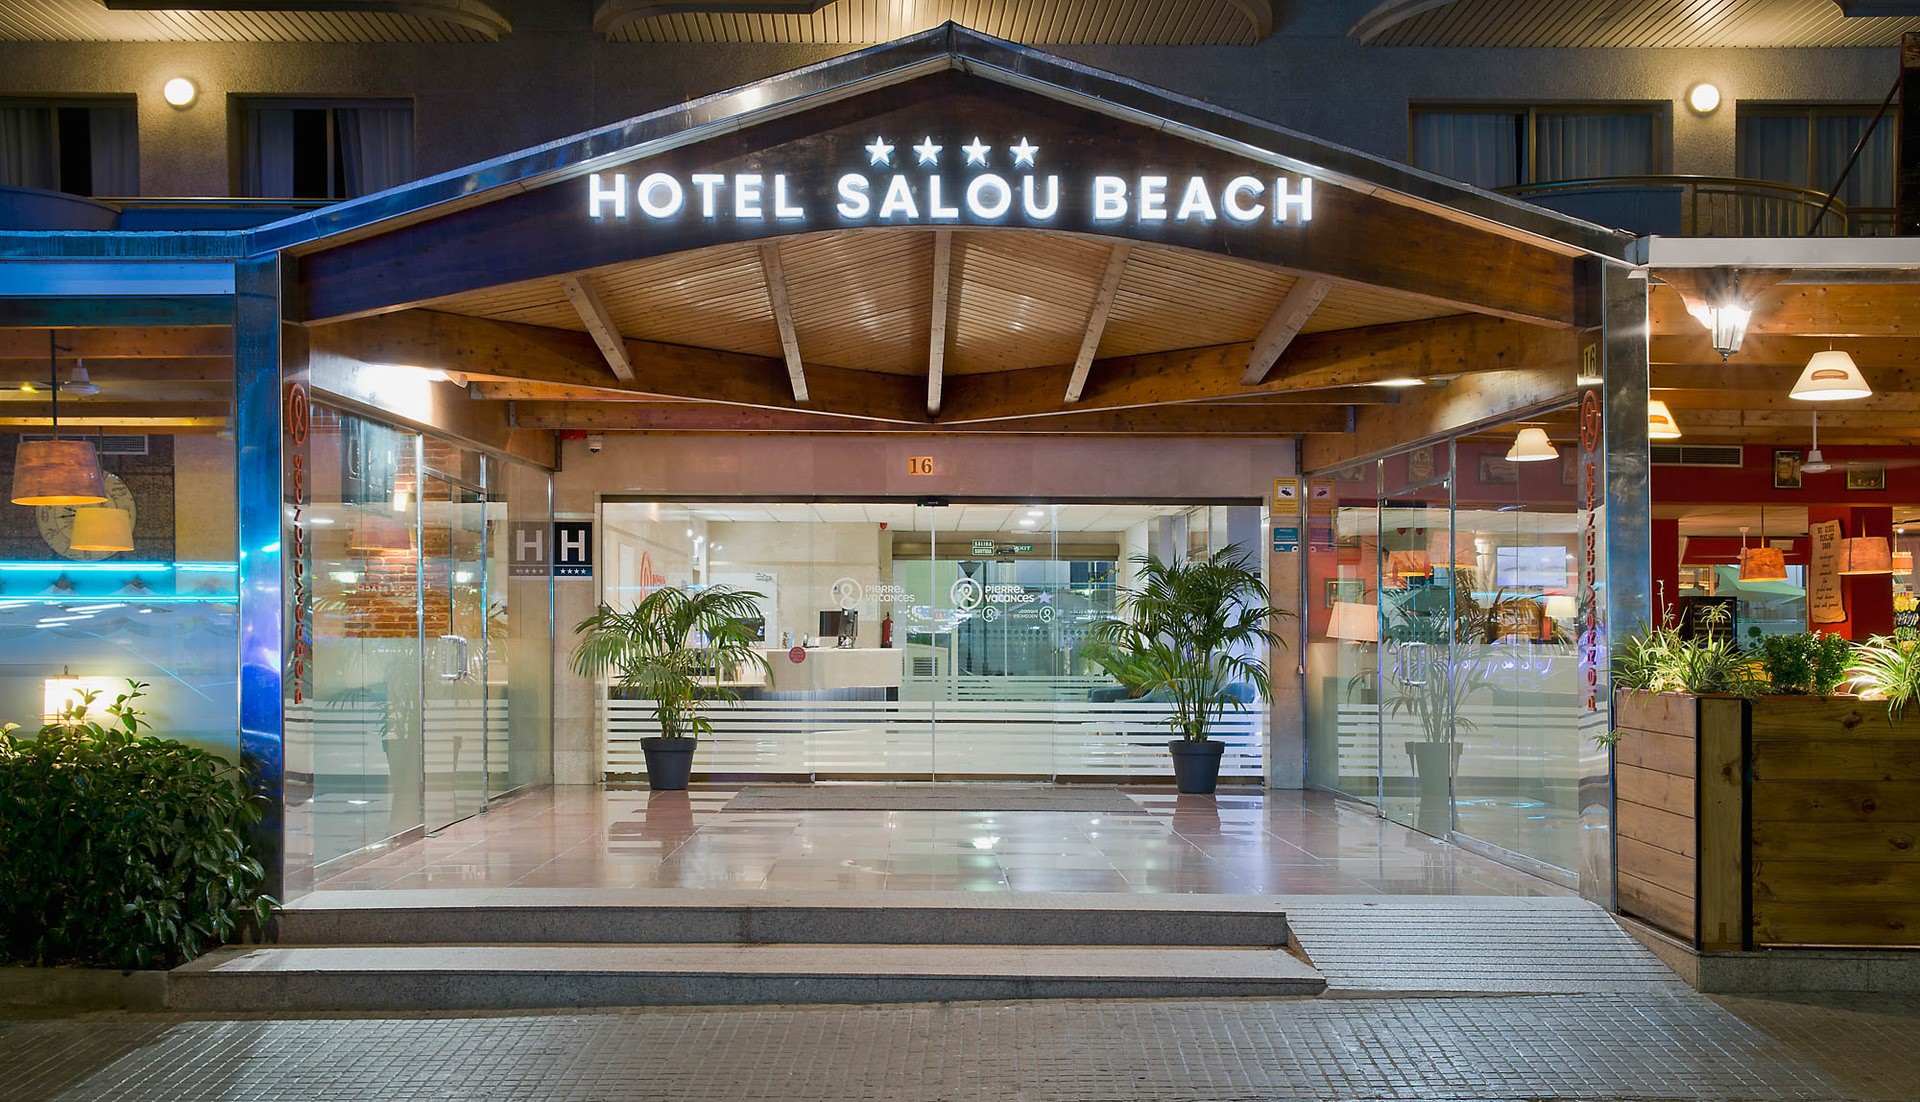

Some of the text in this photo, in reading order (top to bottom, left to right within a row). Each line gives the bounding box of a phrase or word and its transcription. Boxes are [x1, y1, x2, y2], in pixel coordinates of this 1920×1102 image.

[588, 172, 1314, 222] HOTEL SALOU BEACH
[910, 458, 932, 474] 16
[561, 529, 586, 562] H
